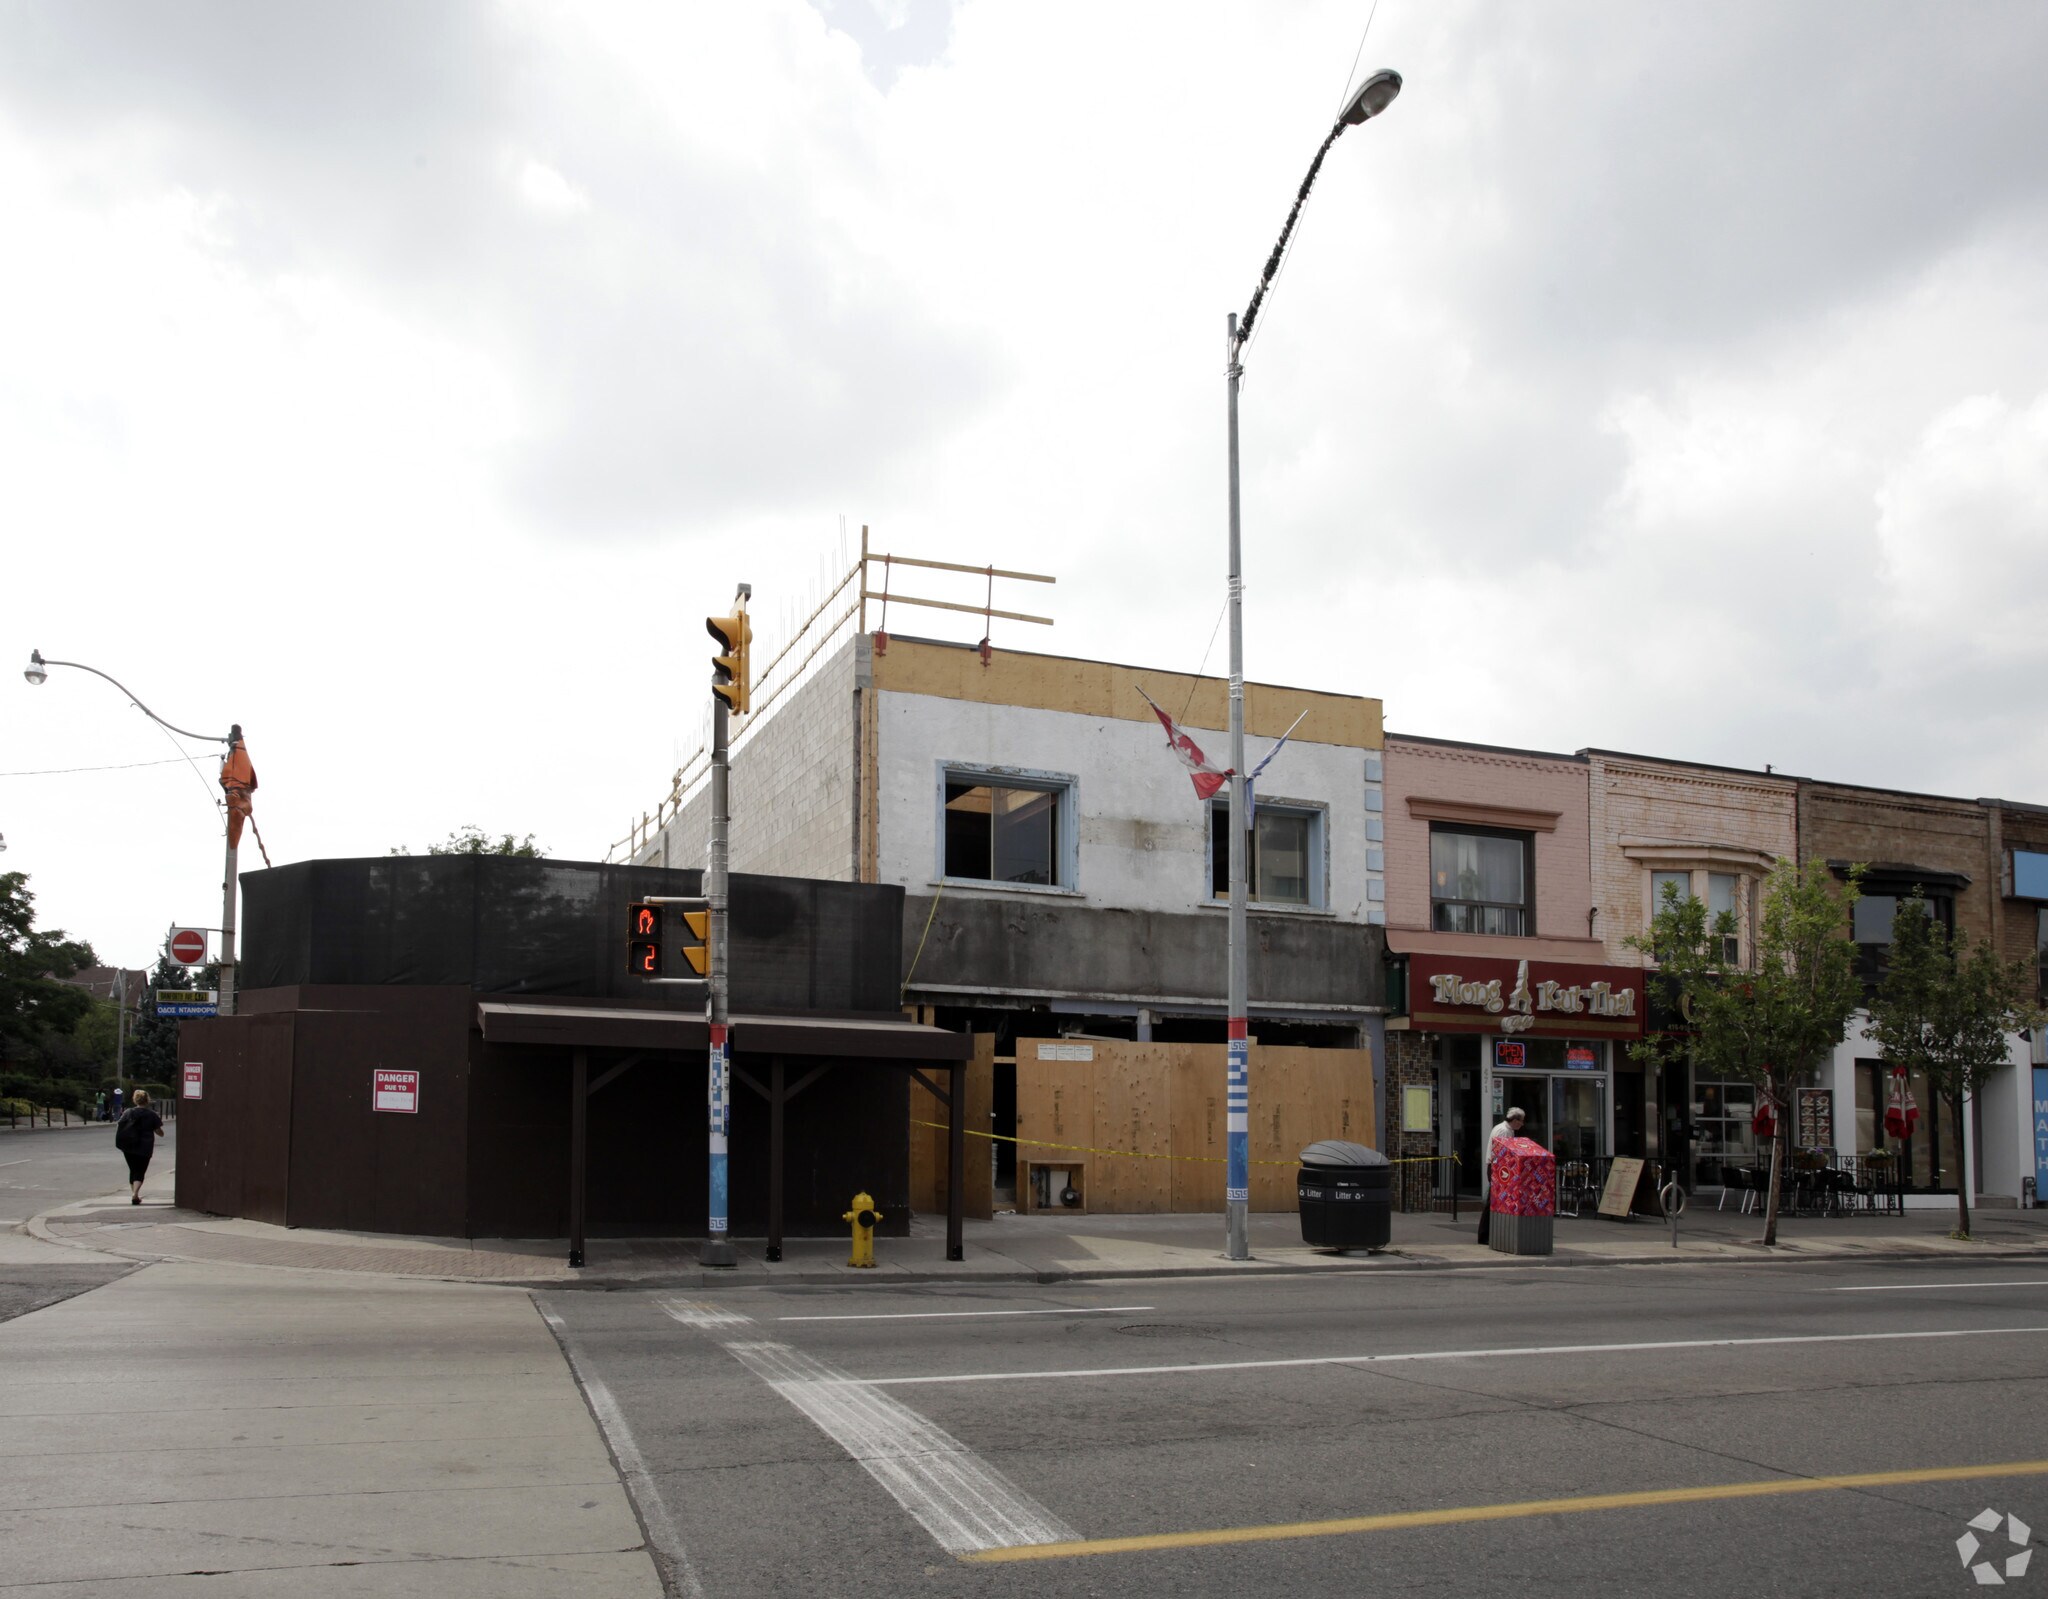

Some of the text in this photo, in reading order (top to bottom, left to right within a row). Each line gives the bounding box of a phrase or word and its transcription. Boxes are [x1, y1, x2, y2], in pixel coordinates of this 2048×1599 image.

[644, 945, 655, 970] 2
[1429, 973, 1504, 1013] Mong
[1535, 980, 1585, 1013] Kut
[1580, 981, 1636, 1016] Thai
[1497, 1043, 1524, 1057] OPEN
[377, 1073, 415, 1083] DANGER
[1306, 1188, 1323, 1199] Litter
[1335, 1190, 1352, 1200] Litter
